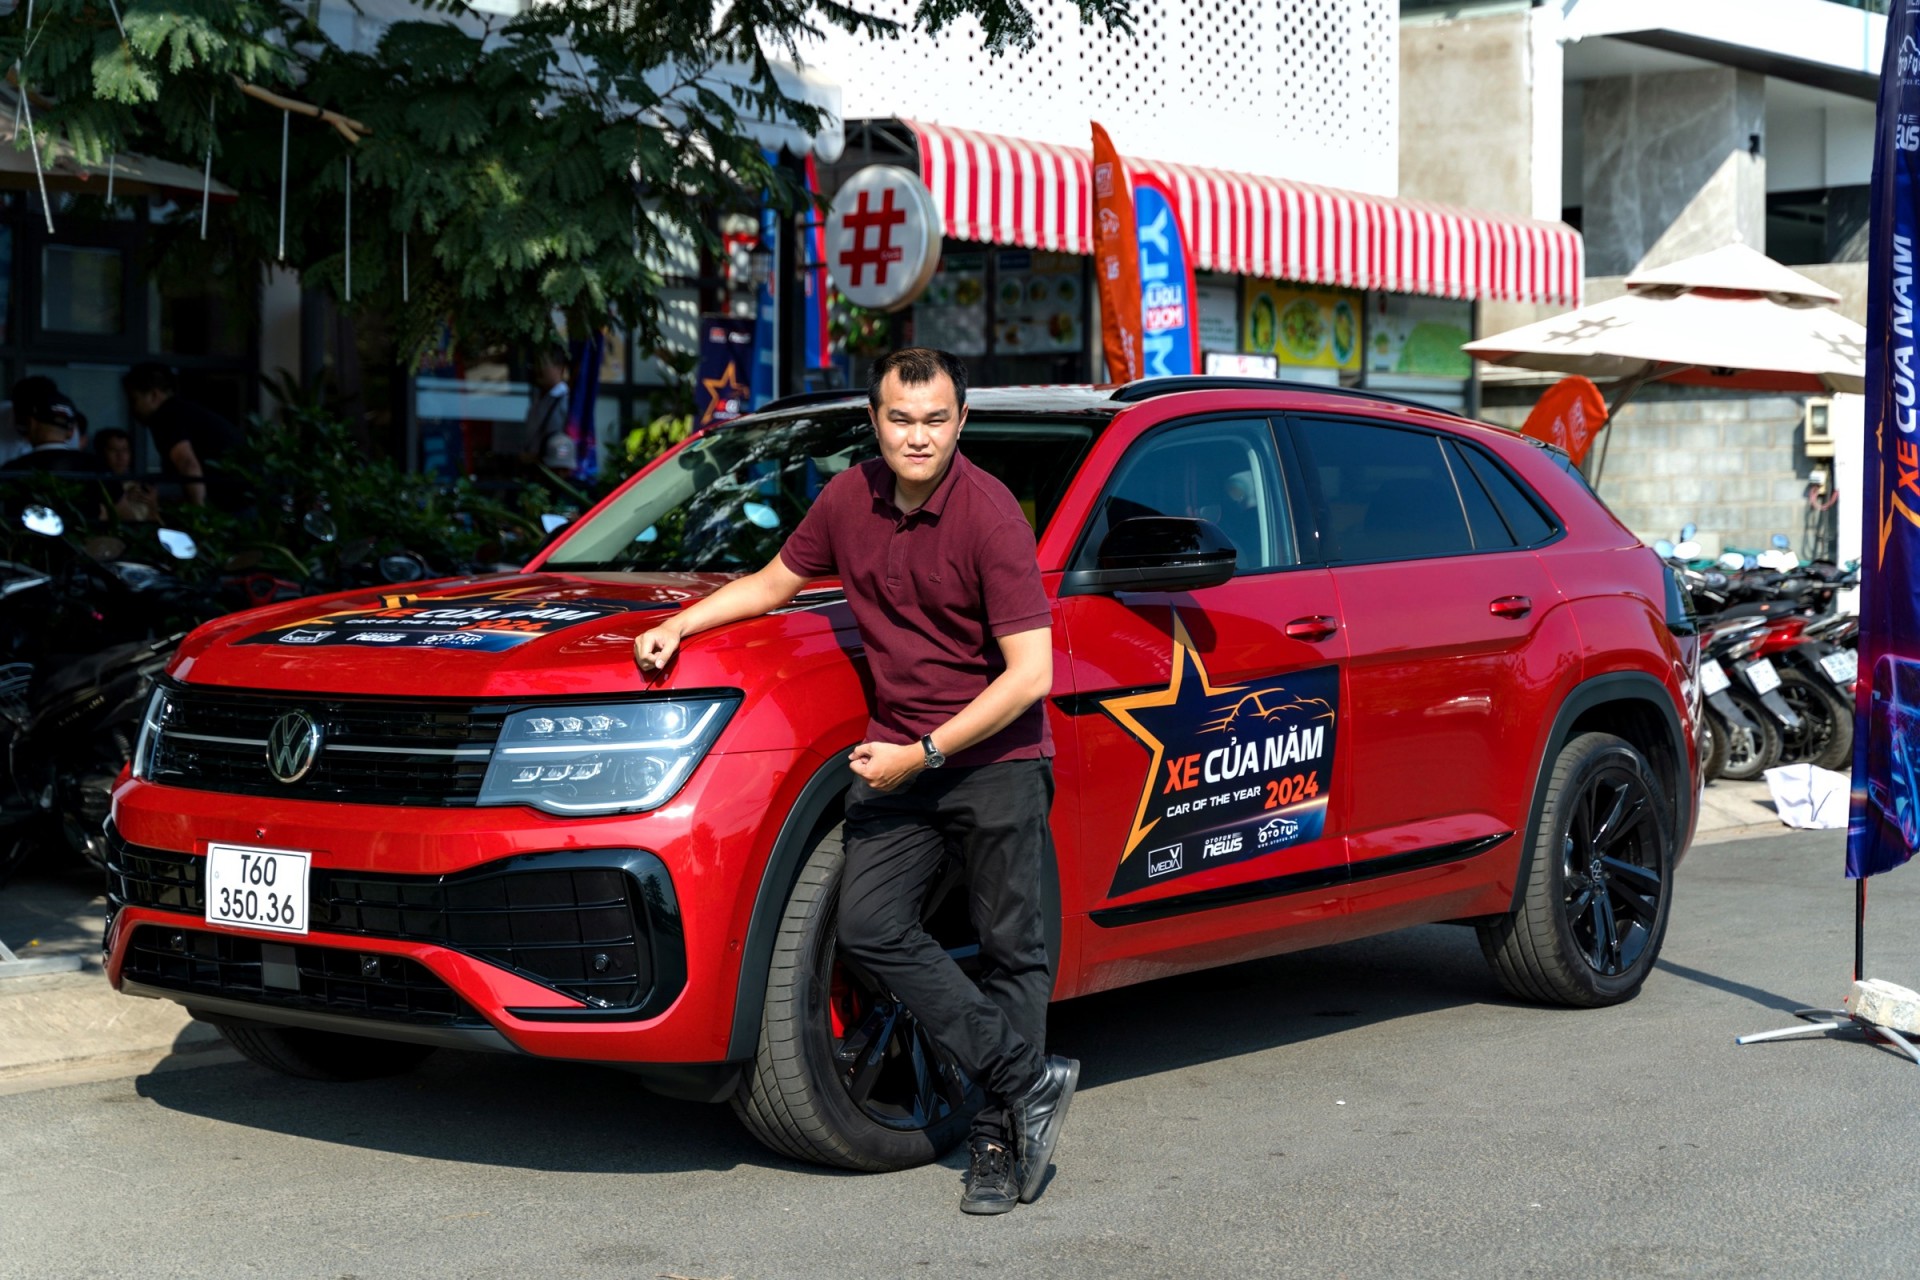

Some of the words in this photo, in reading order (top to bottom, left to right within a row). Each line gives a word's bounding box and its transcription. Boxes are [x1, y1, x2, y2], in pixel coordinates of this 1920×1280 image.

[1163, 753, 1201, 794] XE
[1204, 736, 1260, 784] CỦA
[1263, 725, 1324, 771] NĂM
[1166, 801, 1190, 818] CAR
[1192, 799, 1208, 812] OF
[1210, 793, 1231, 807] THE
[1233, 786, 1262, 801] YEAR
[1264, 771, 1319, 809] 2024
[240, 854, 277, 887] T60
[219, 887, 295, 925] 350.36
